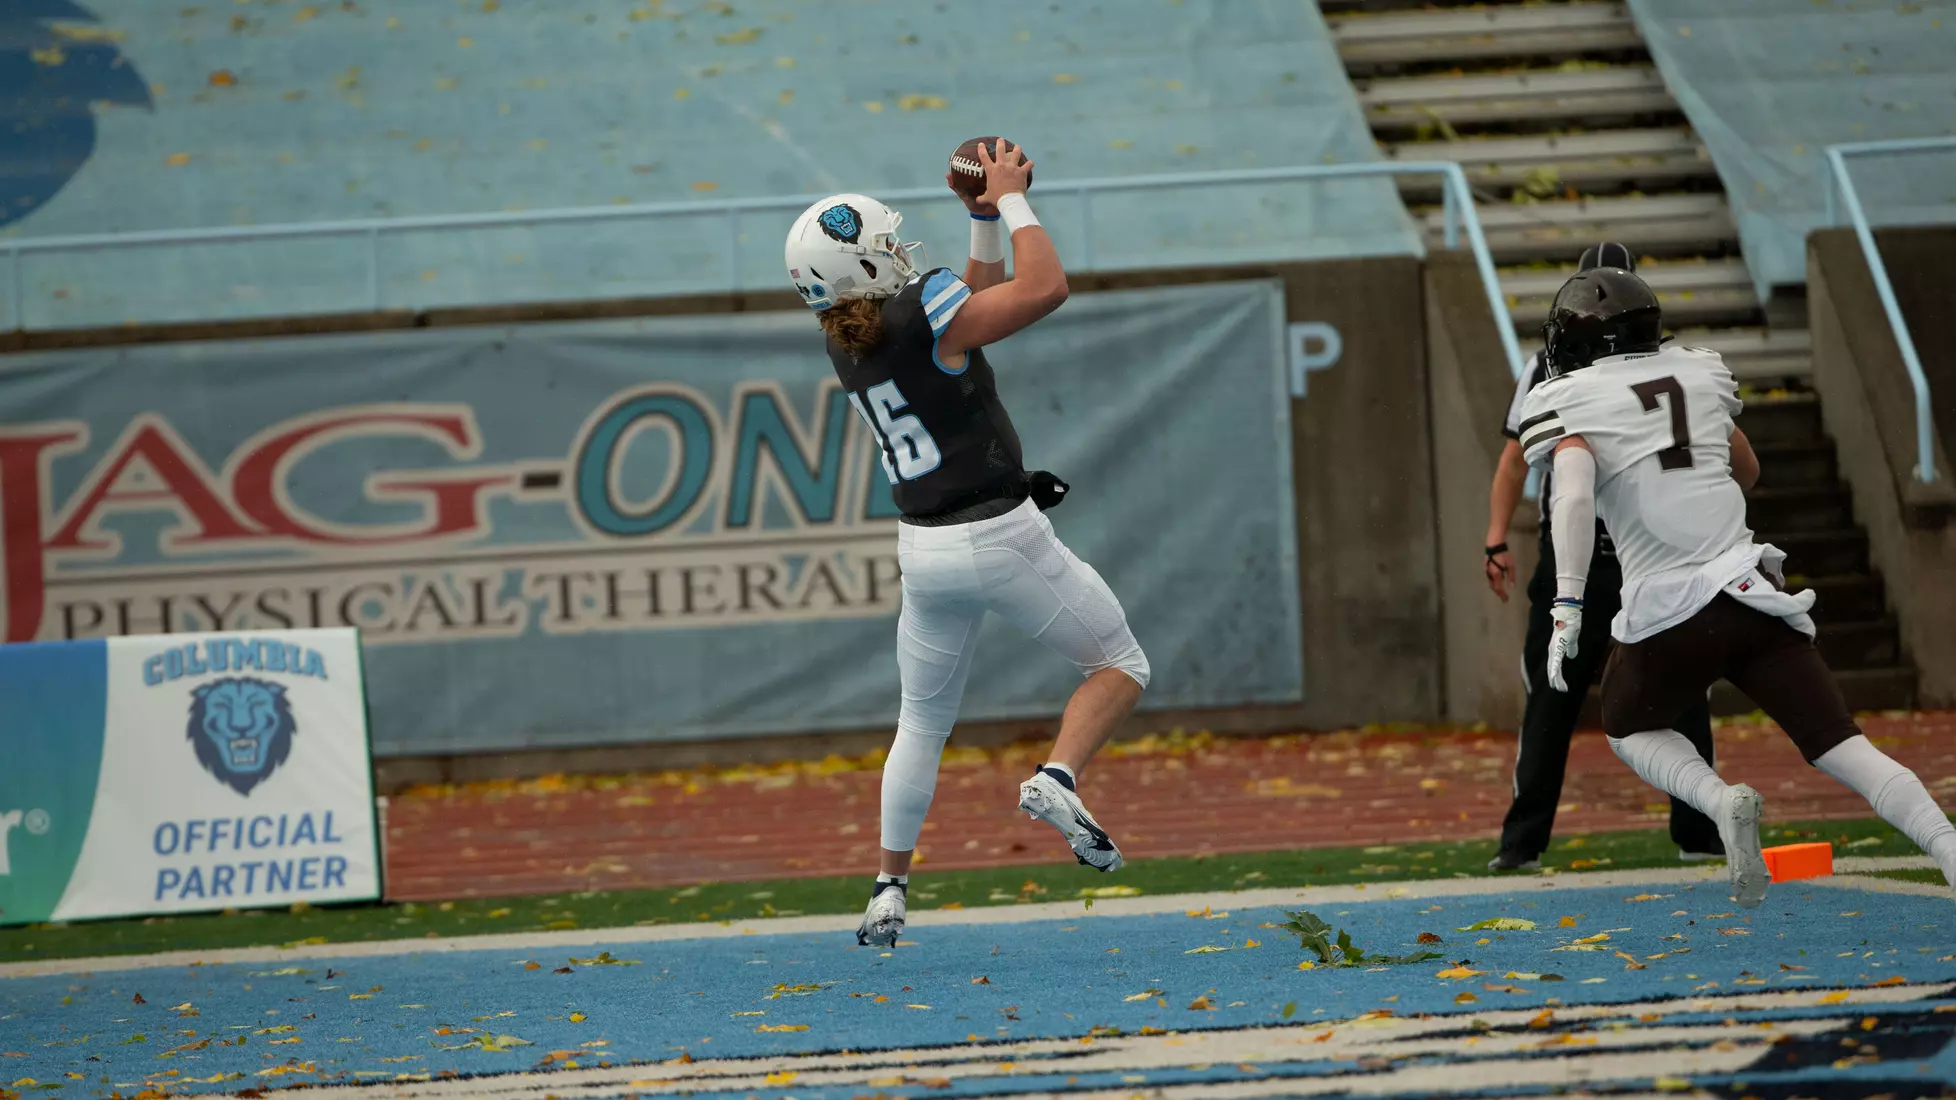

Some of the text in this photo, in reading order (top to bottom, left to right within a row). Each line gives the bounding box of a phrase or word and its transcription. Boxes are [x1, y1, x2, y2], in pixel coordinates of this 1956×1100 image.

[1628, 374, 1696, 474] 7
[57, 556, 899, 640] PHYSICAL THERAP
[143, 637, 329, 687] COLUMBIA
[153, 810, 342, 856] OFFICIAL
[155, 856, 348, 901] PARTNER
